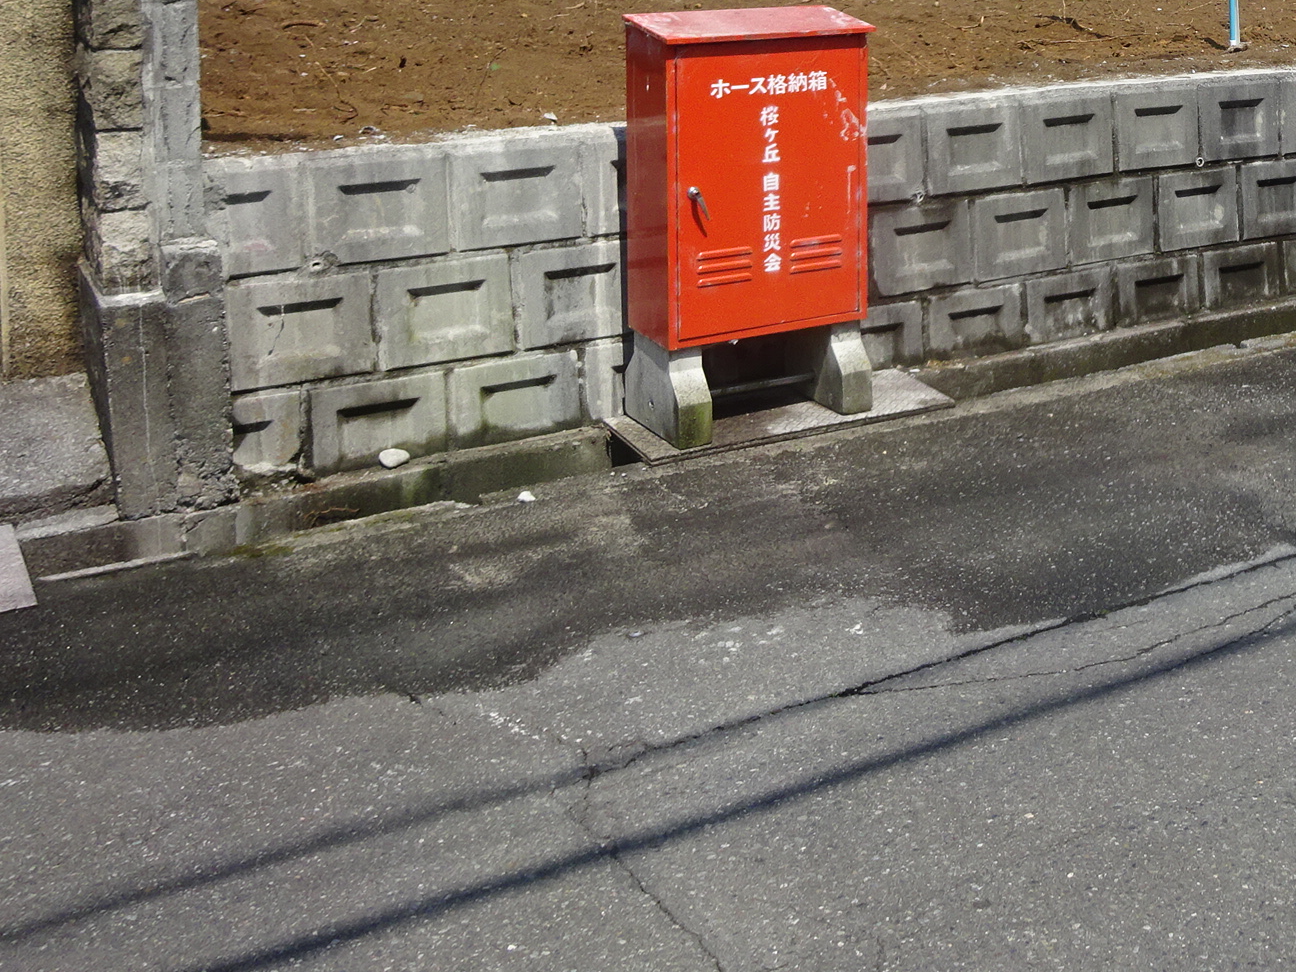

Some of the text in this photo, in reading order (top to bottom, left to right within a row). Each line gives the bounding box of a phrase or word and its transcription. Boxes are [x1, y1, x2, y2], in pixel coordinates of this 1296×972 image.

[710, 70, 828, 99] ホース格納箱
[762, 172, 782, 273] 自主防災会
